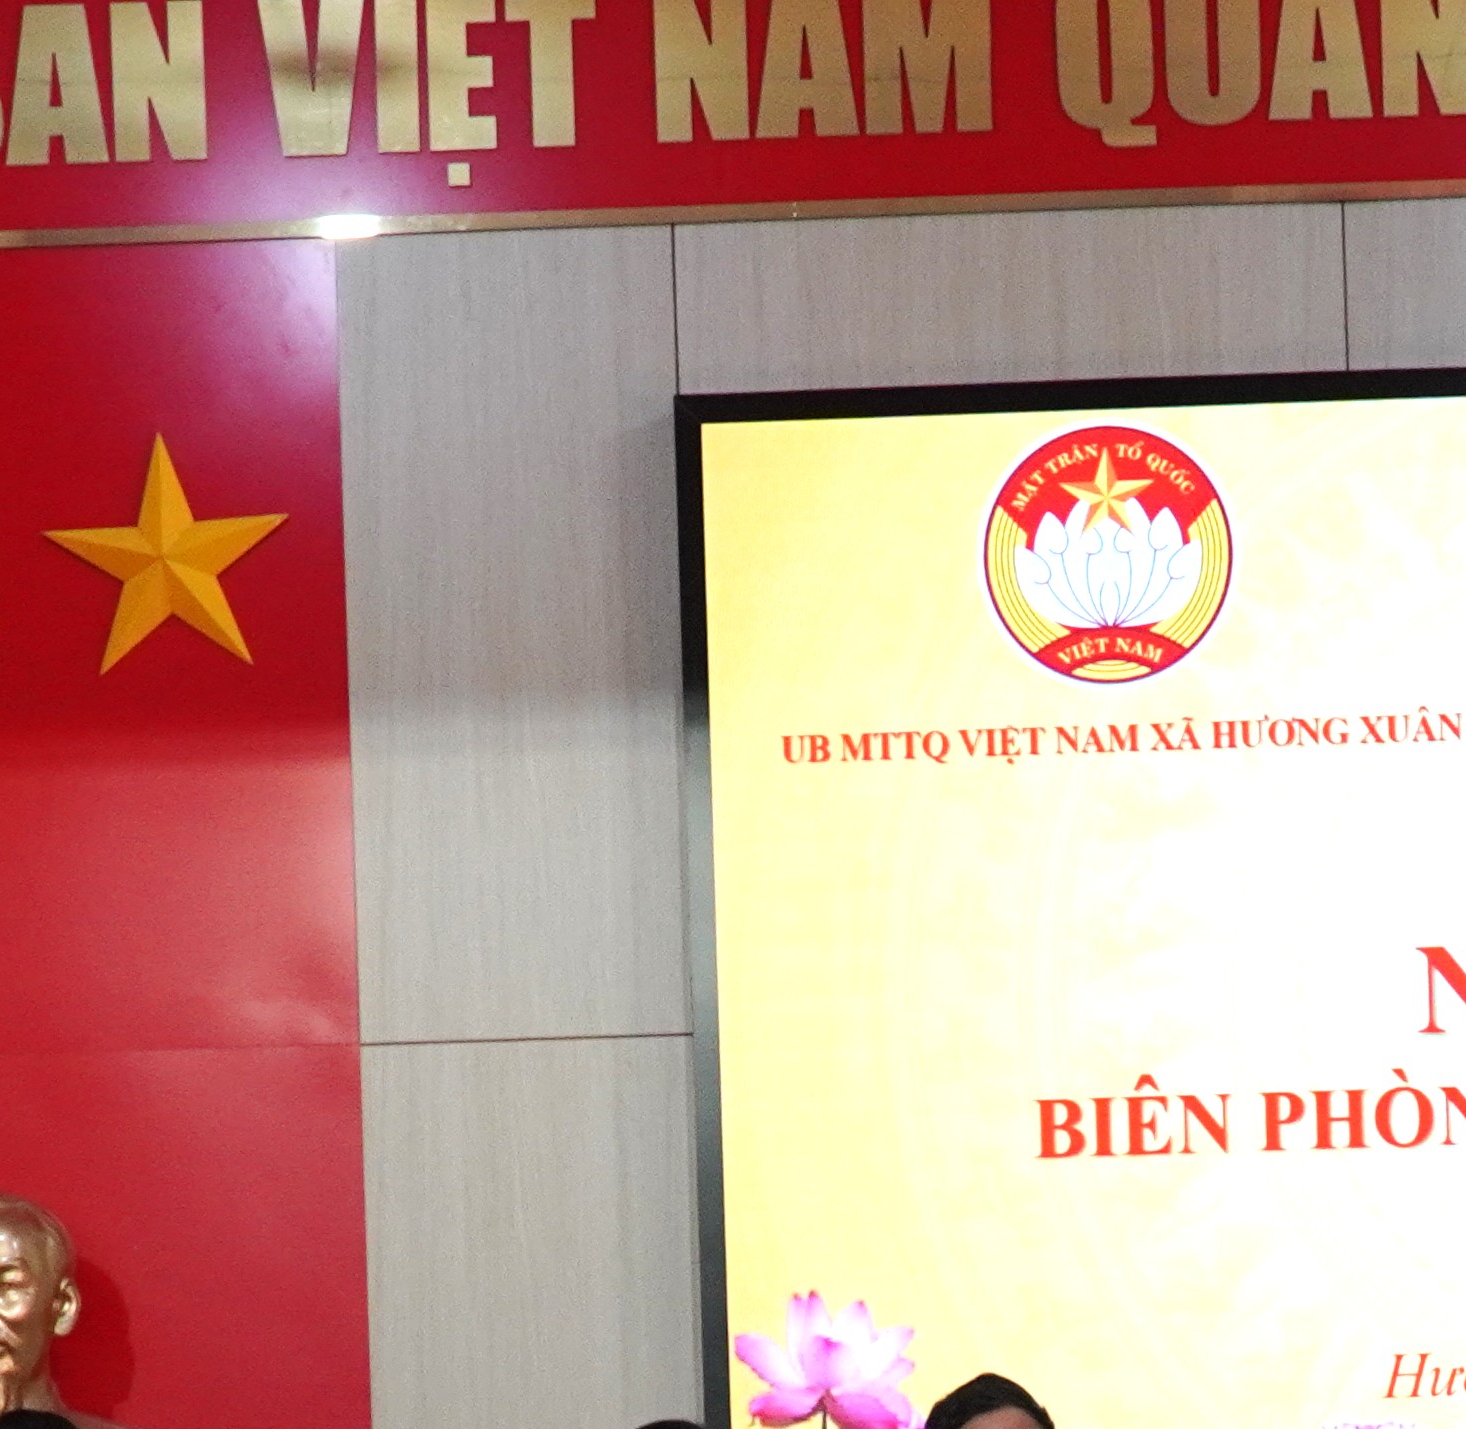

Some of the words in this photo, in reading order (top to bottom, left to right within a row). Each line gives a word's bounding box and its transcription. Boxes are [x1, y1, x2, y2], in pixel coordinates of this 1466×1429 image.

[1114, 637, 1164, 664] NAM
[781, 734, 832, 764] UB
[840, 730, 951, 765] MTTQ
[957, 725, 1046, 765] VIỆT
[1055, 723, 1139, 755] NAM
[1150, 716, 1202, 751] XÃ
[1211, 715, 1349, 750] HƯƠNG
[1359, 705, 1462, 745] XUÂN
[1036, 1073, 1230, 1159] BIÊN
